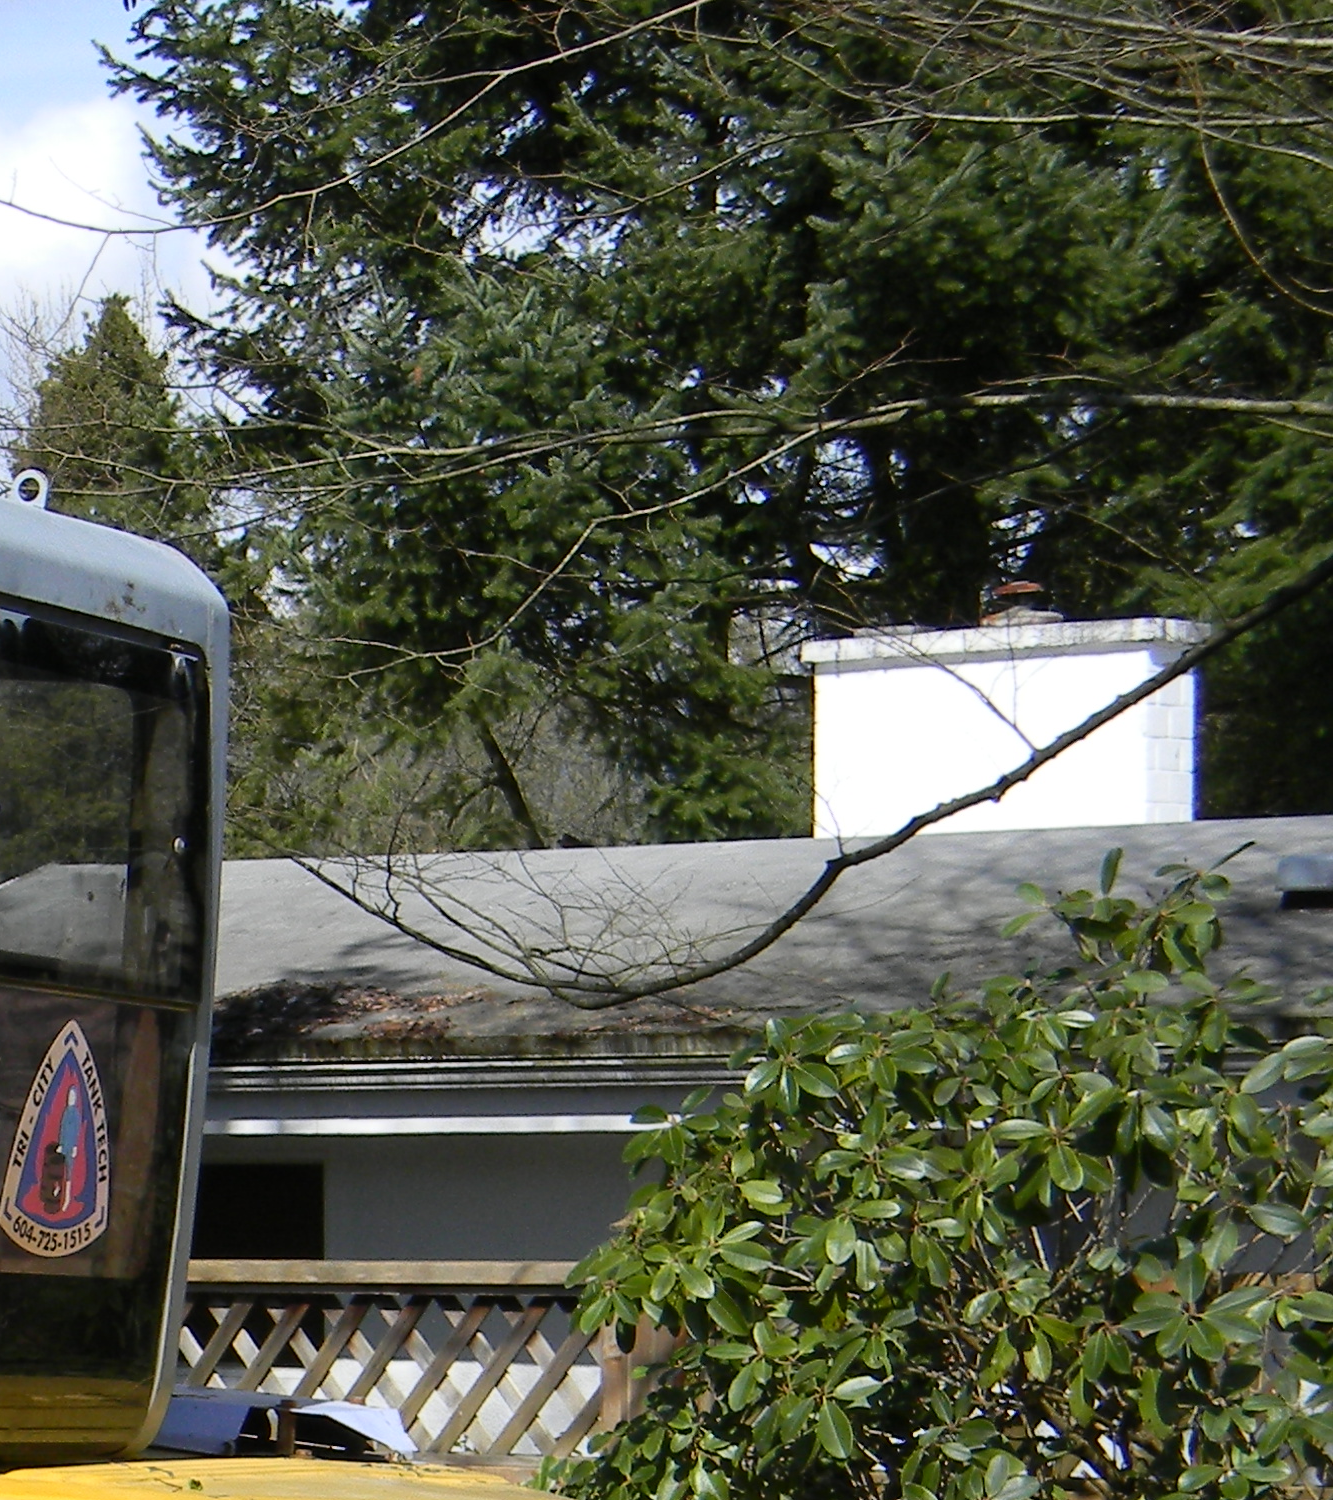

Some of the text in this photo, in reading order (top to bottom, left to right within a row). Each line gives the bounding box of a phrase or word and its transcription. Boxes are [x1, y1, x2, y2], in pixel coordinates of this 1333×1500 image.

[12, 1130, 30, 1168] TRI
[33, 1057, 54, 1107] CITY
[82, 1051, 102, 1115] TANK
[96, 1119, 108, 1183] TECH
[13, 1216, 91, 1251] 604-725-1515
